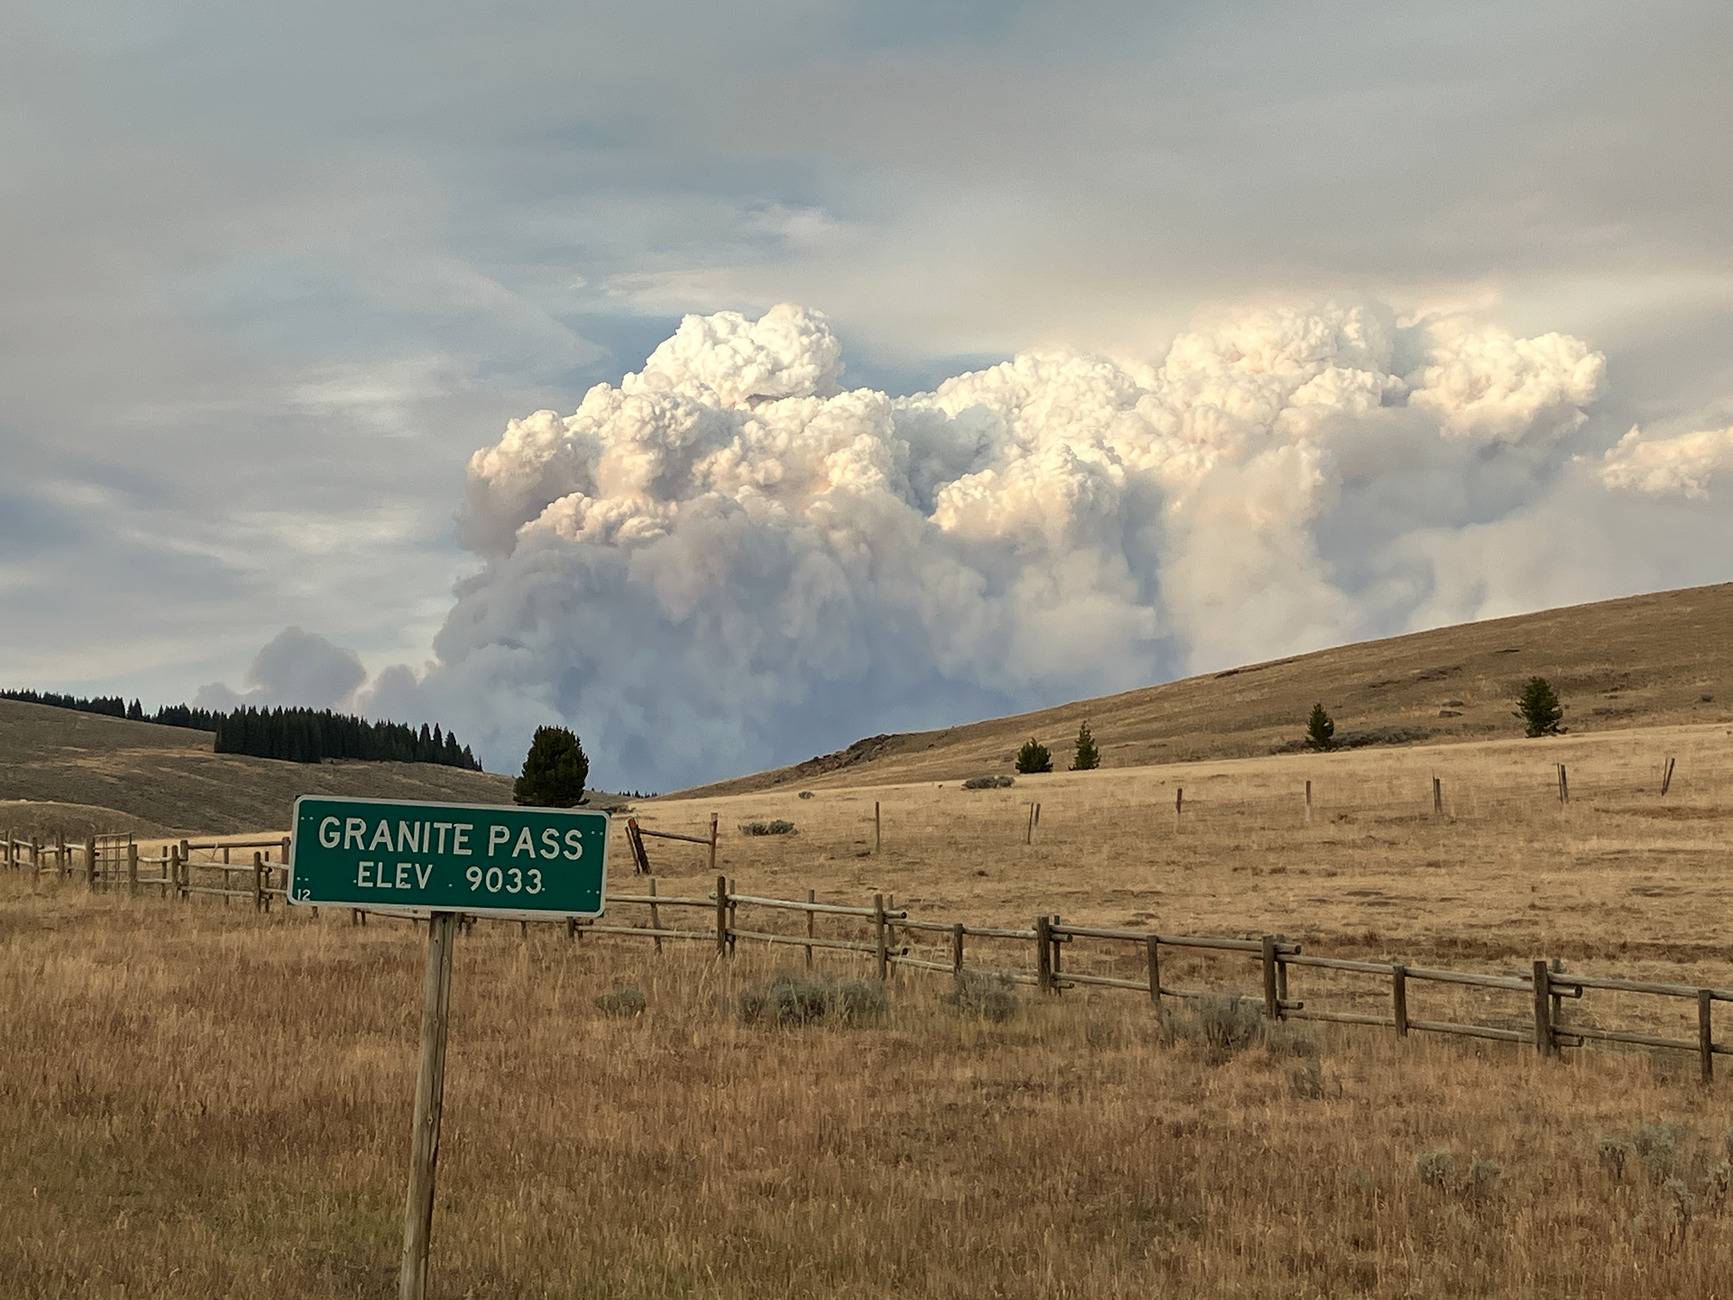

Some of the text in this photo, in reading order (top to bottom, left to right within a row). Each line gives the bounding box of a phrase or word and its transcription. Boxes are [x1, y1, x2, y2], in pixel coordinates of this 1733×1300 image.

[319, 816, 583, 861] GRANITE PASS
[357, 861, 542, 894] ELEV 9033
[297, 888, 311, 901] 12
